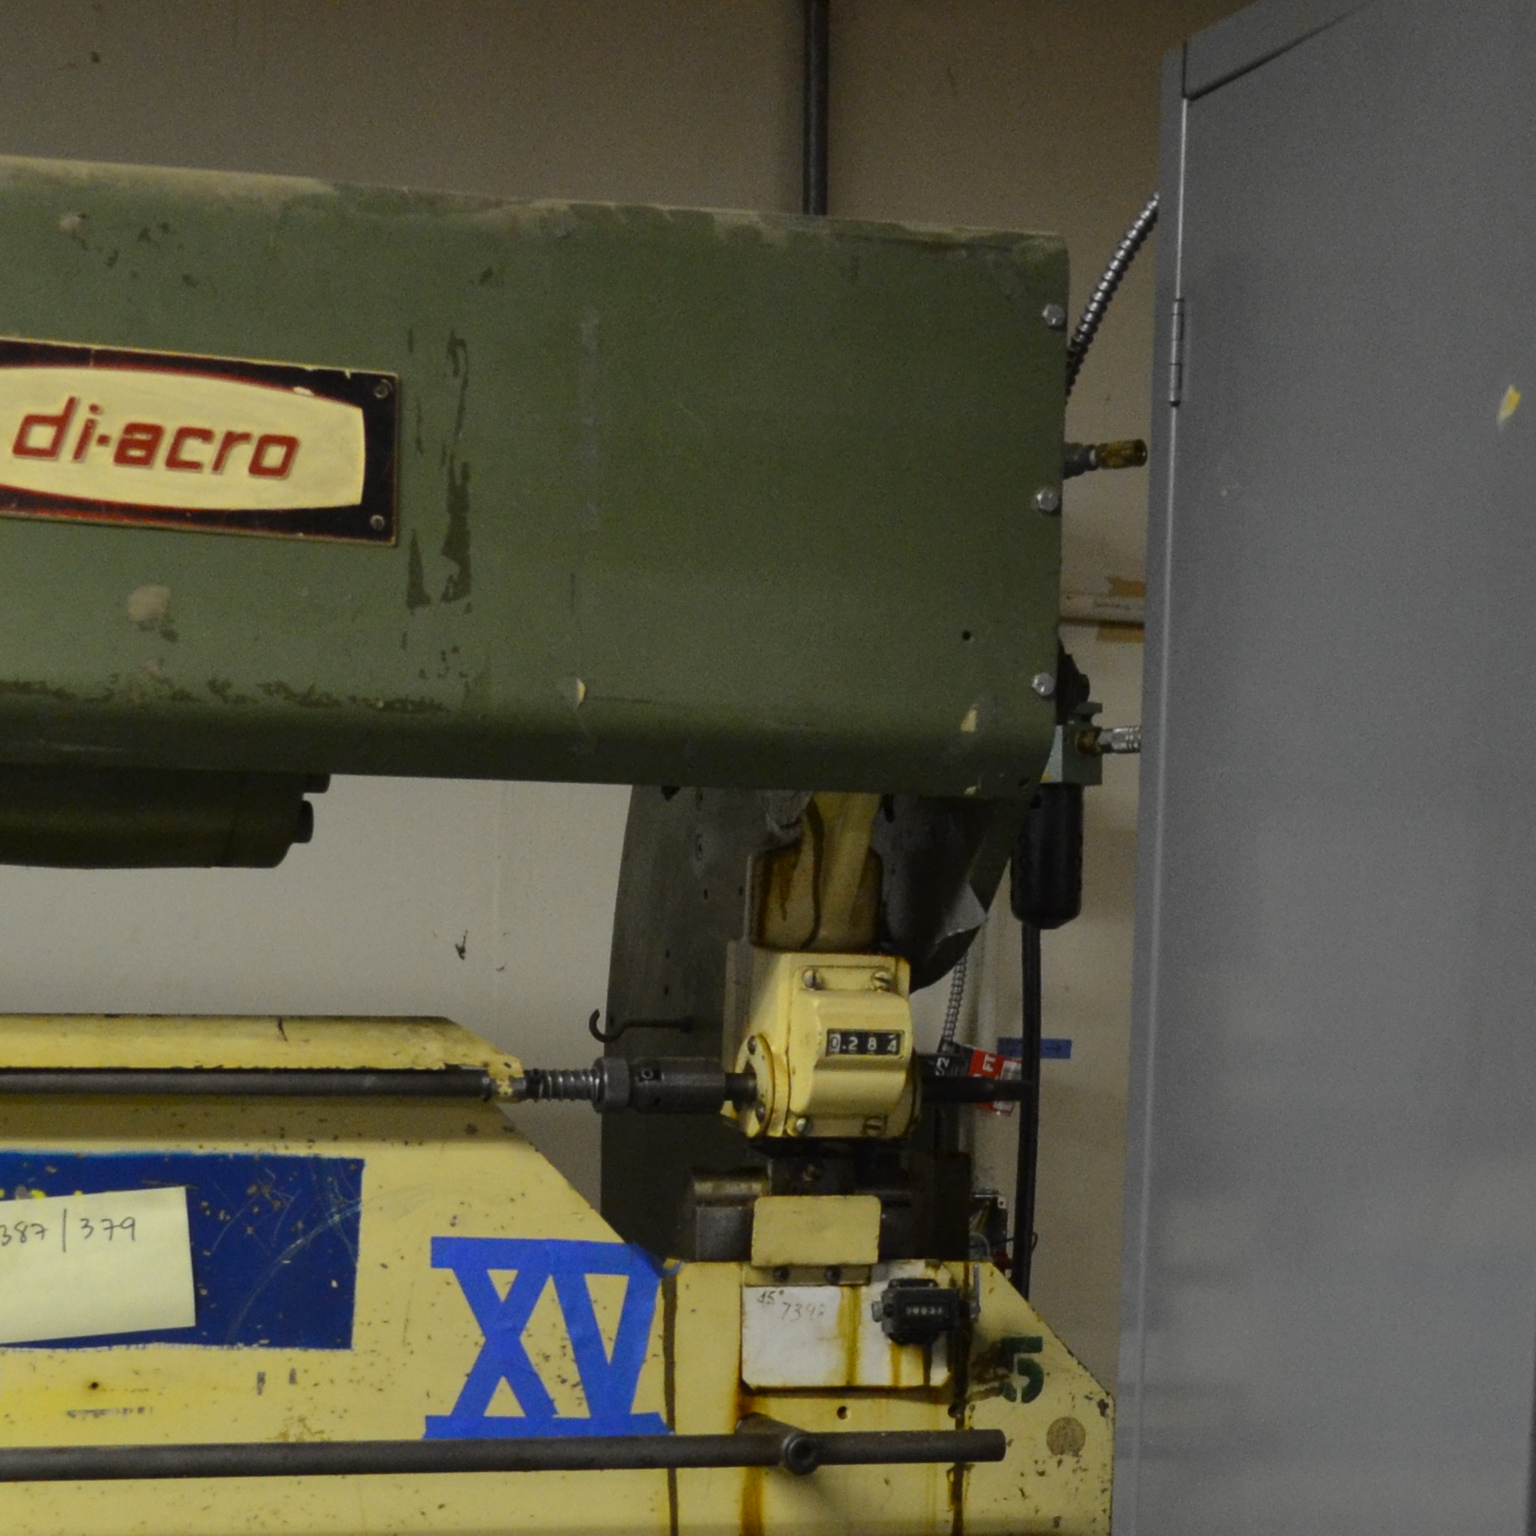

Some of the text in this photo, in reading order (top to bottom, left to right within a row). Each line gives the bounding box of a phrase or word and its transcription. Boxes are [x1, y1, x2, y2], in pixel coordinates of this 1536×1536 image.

[80, 1216, 137, 1242] 379
[424, 1236, 672, 1438] XV
[998, 1336, 1045, 1403] 5
